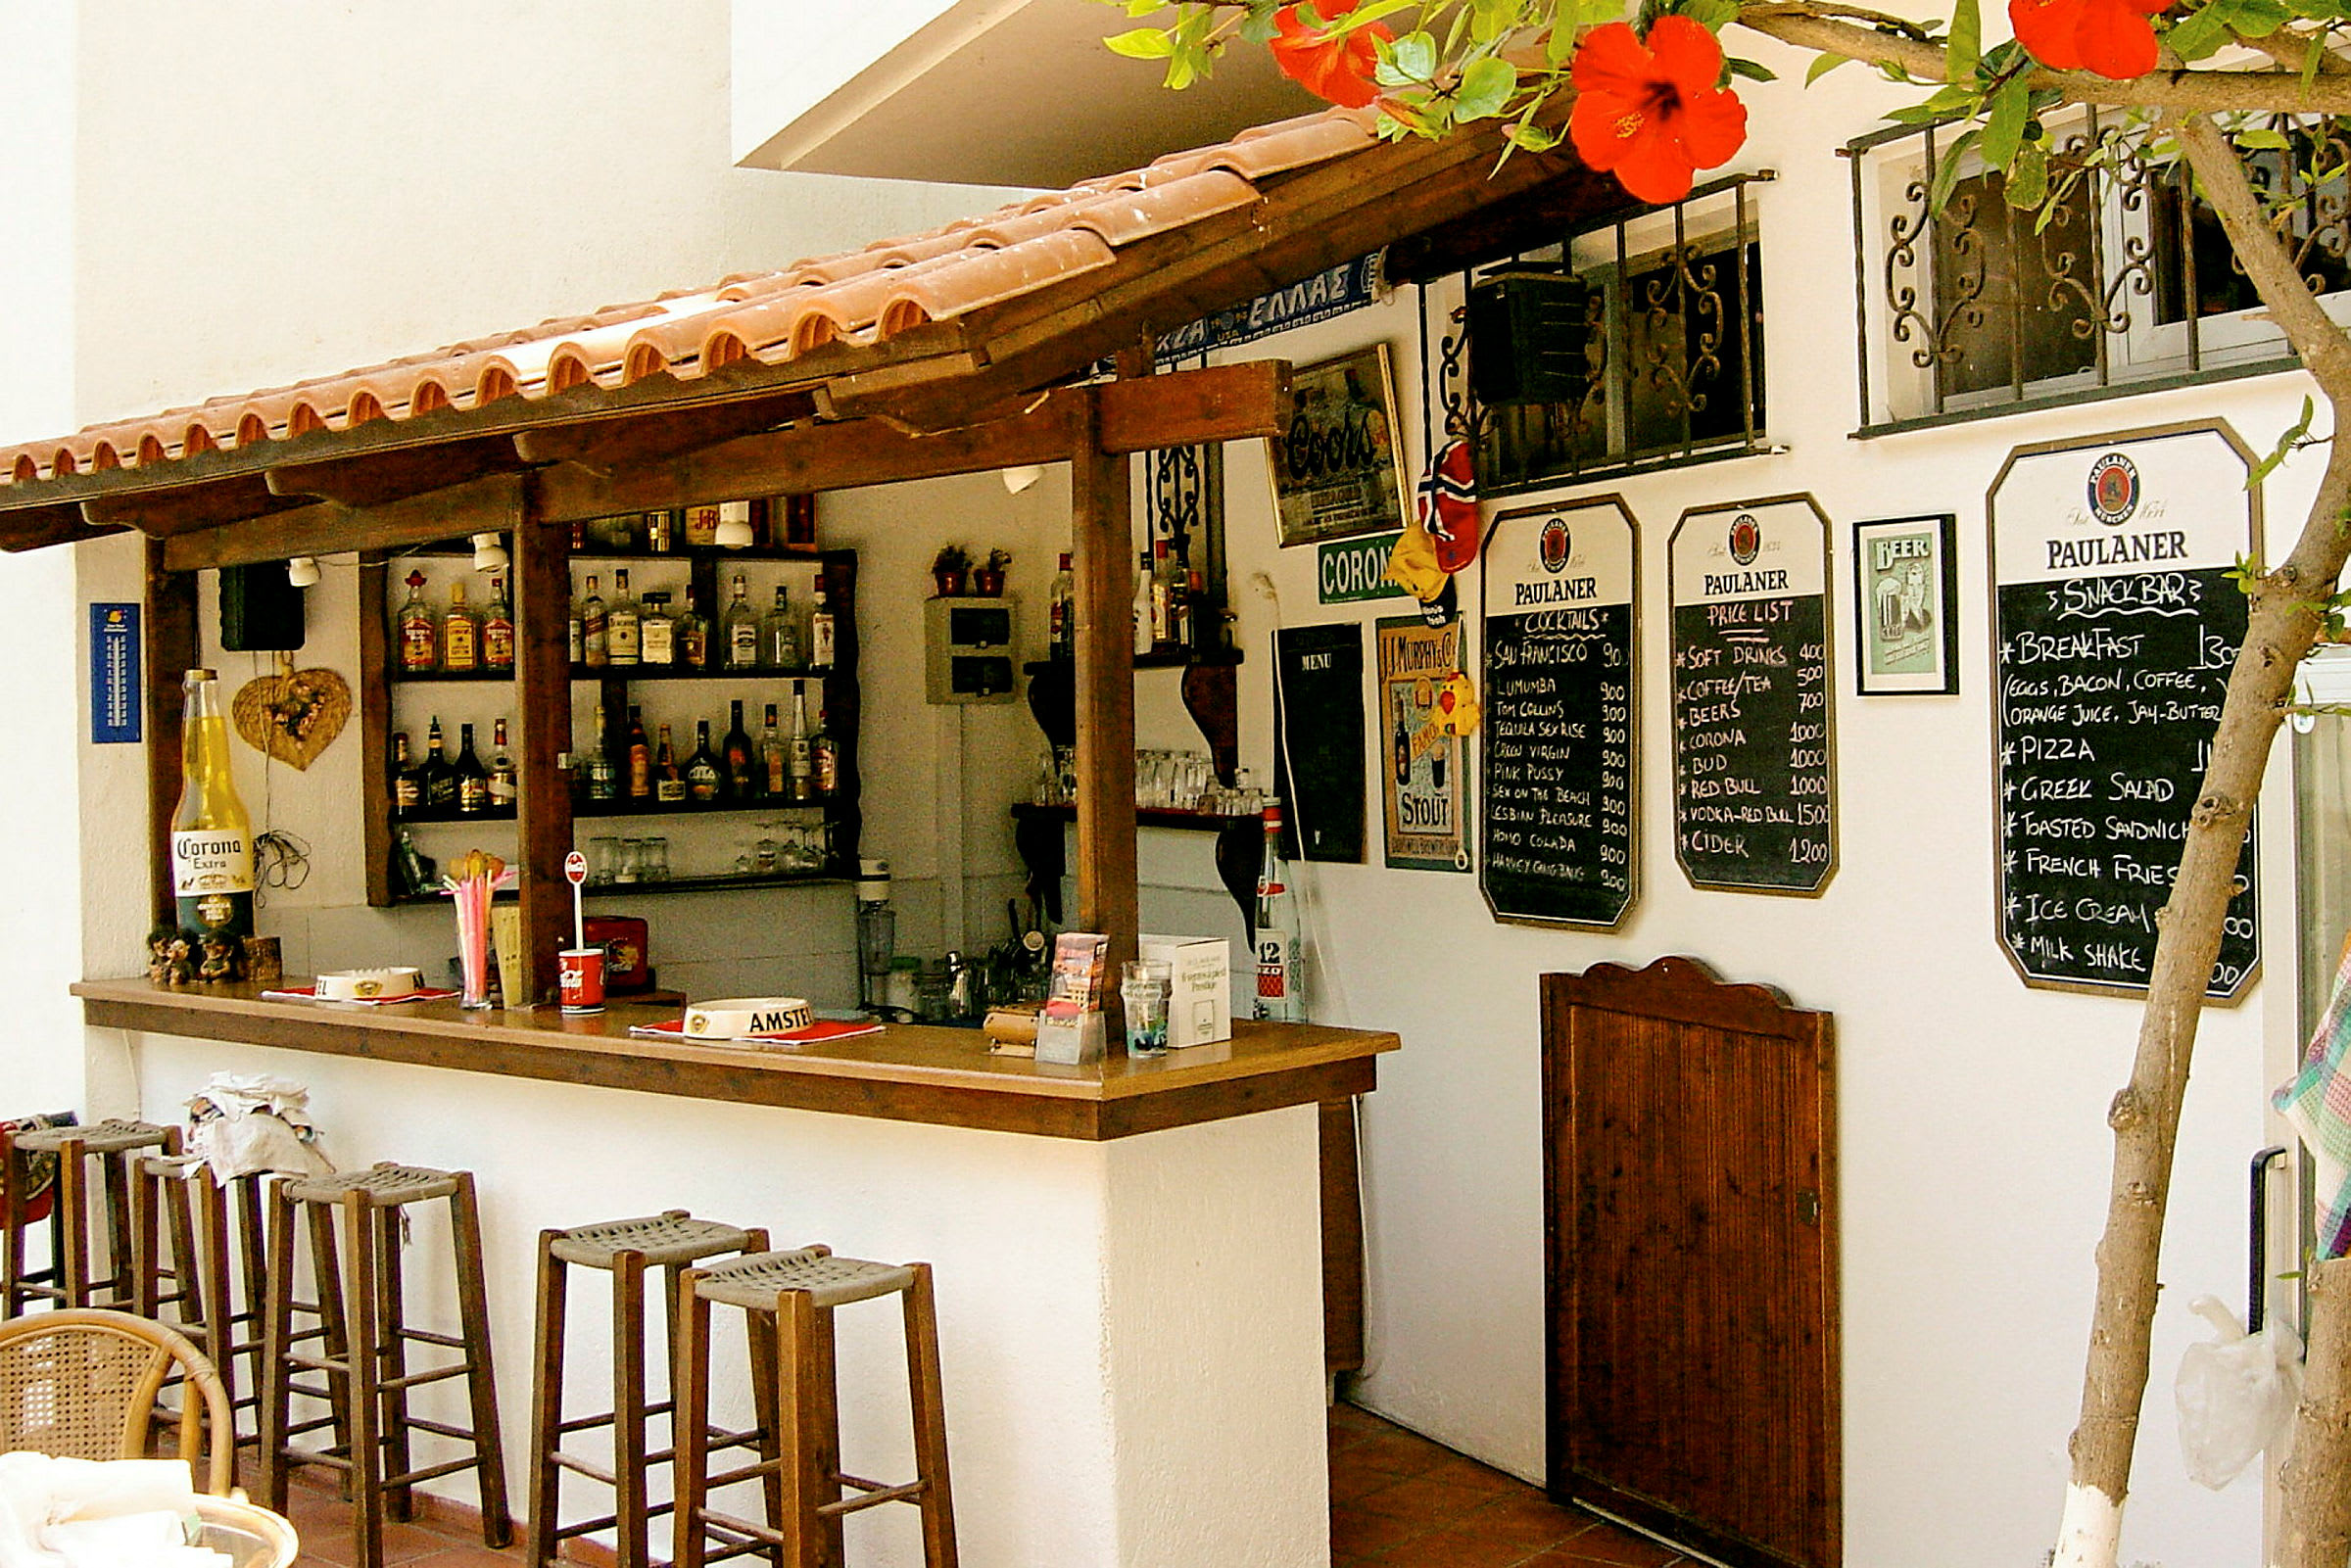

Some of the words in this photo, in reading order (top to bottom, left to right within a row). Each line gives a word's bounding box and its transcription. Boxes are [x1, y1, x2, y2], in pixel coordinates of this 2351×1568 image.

[1876, 539, 1931, 571] BEER
[2046, 531, 2188, 569] PAULANER
[1322, 546, 1399, 595] CORON
[1704, 570, 1789, 595] PAULANER
[1515, 578, 1597, 605] PAULANER
[1525, 608, 1600, 633] COCKTAILS
[1707, 603, 1748, 627] PRICE
[1753, 600, 1794, 622] LIST
[1688, 645, 1722, 670] SOFT
[1733, 645, 1788, 667] DRINKS
[1799, 642, 1825, 661] 400
[2016, 628, 2145, 664] BREAKFAST
[1497, 678, 1556, 696] LUMUMBA
[1601, 682, 1625, 701] 900
[1797, 665, 1823, 687] 500
[1519, 700, 1564, 719] COLLINS
[1602, 704, 1626, 722] 900
[1689, 699, 1741, 727] BEERS
[1799, 692, 1824, 714] 700
[2010, 704, 2068, 726] ORANGE
[1603, 727, 1625, 743] 900
[1691, 728, 1747, 749] CORONA
[1790, 722, 1825, 742] 1000
[1529, 744, 1570, 761] VIRGIN
[1602, 749, 1626, 768] 900
[1693, 754, 1727, 775] BUD
[1790, 748, 1827, 769] 1000
[2021, 736, 2095, 764] PIZZA
[1494, 762, 1520, 781] PINK
[1527, 763, 1564, 782] PUSSY
[1602, 771, 1624, 790] 900
[1692, 780, 1720, 799] RED
[1724, 778, 1762, 795] BULL
[1790, 775, 1827, 795] 1000
[2021, 777, 2092, 802] GREEK
[2108, 772, 2175, 802] SALAD
[1492, 784, 1511, 798] SEX
[1514, 787, 1528, 799] ON
[1555, 785, 1590, 806] BEACH
[1601, 795, 1625, 817] 900
[1765, 806, 1795, 824] BULL
[1798, 802, 1829, 826] 1500
[1602, 818, 1627, 837] 900
[2021, 811, 2095, 839] TOASTED
[177, 837, 241, 859] Corona
[1529, 833, 1576, 853] COLADA
[1600, 844, 1626, 865] 900
[1790, 837, 1827, 864] 1200
[194, 858, 226, 870] Extra
[2025, 848, 2101, 879] FRENCH
[1600, 869, 1626, 892] 900
[2025, 893, 2068, 923] ICE
[2076, 898, 2151, 933] CREAM
[1259, 941, 1281, 964] 12
[2031, 936, 2074, 961] MILK
[2085, 943, 2146, 973] SHAKE
